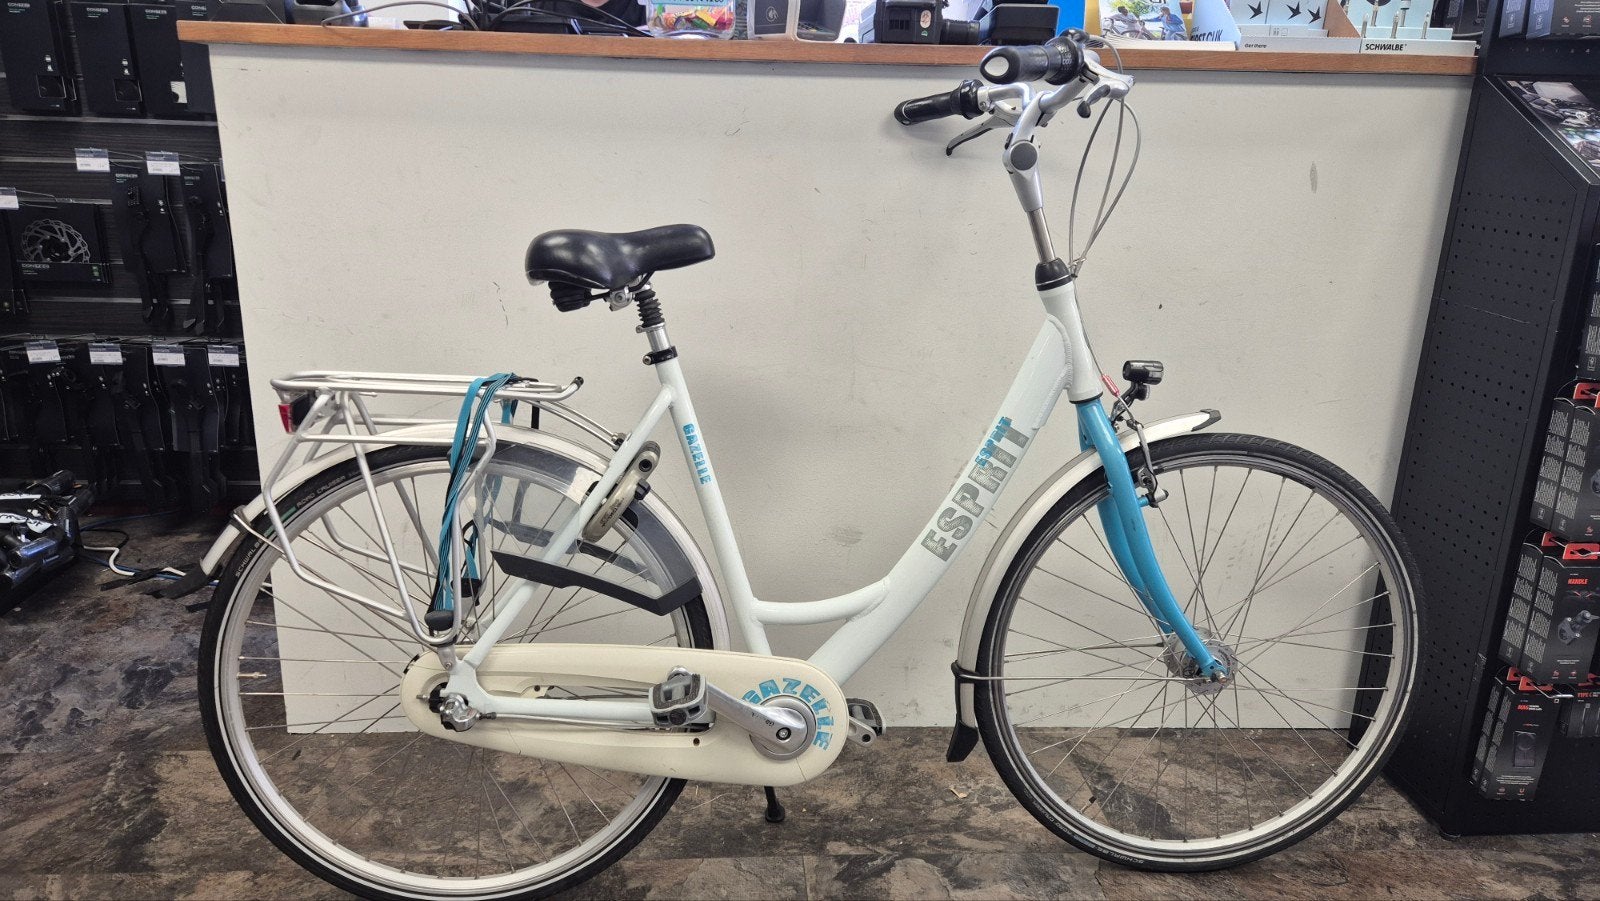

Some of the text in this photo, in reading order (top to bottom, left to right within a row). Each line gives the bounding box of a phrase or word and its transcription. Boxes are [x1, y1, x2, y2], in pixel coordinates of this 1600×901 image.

[1364, 43, 1405, 51] SCHWALBE
[682, 423, 711, 485] GAZELLE
[975, 416, 1012, 468] ESPRIT
[920, 417, 1030, 562] ESPRIT
[741, 677, 835, 751] GAZELLE
